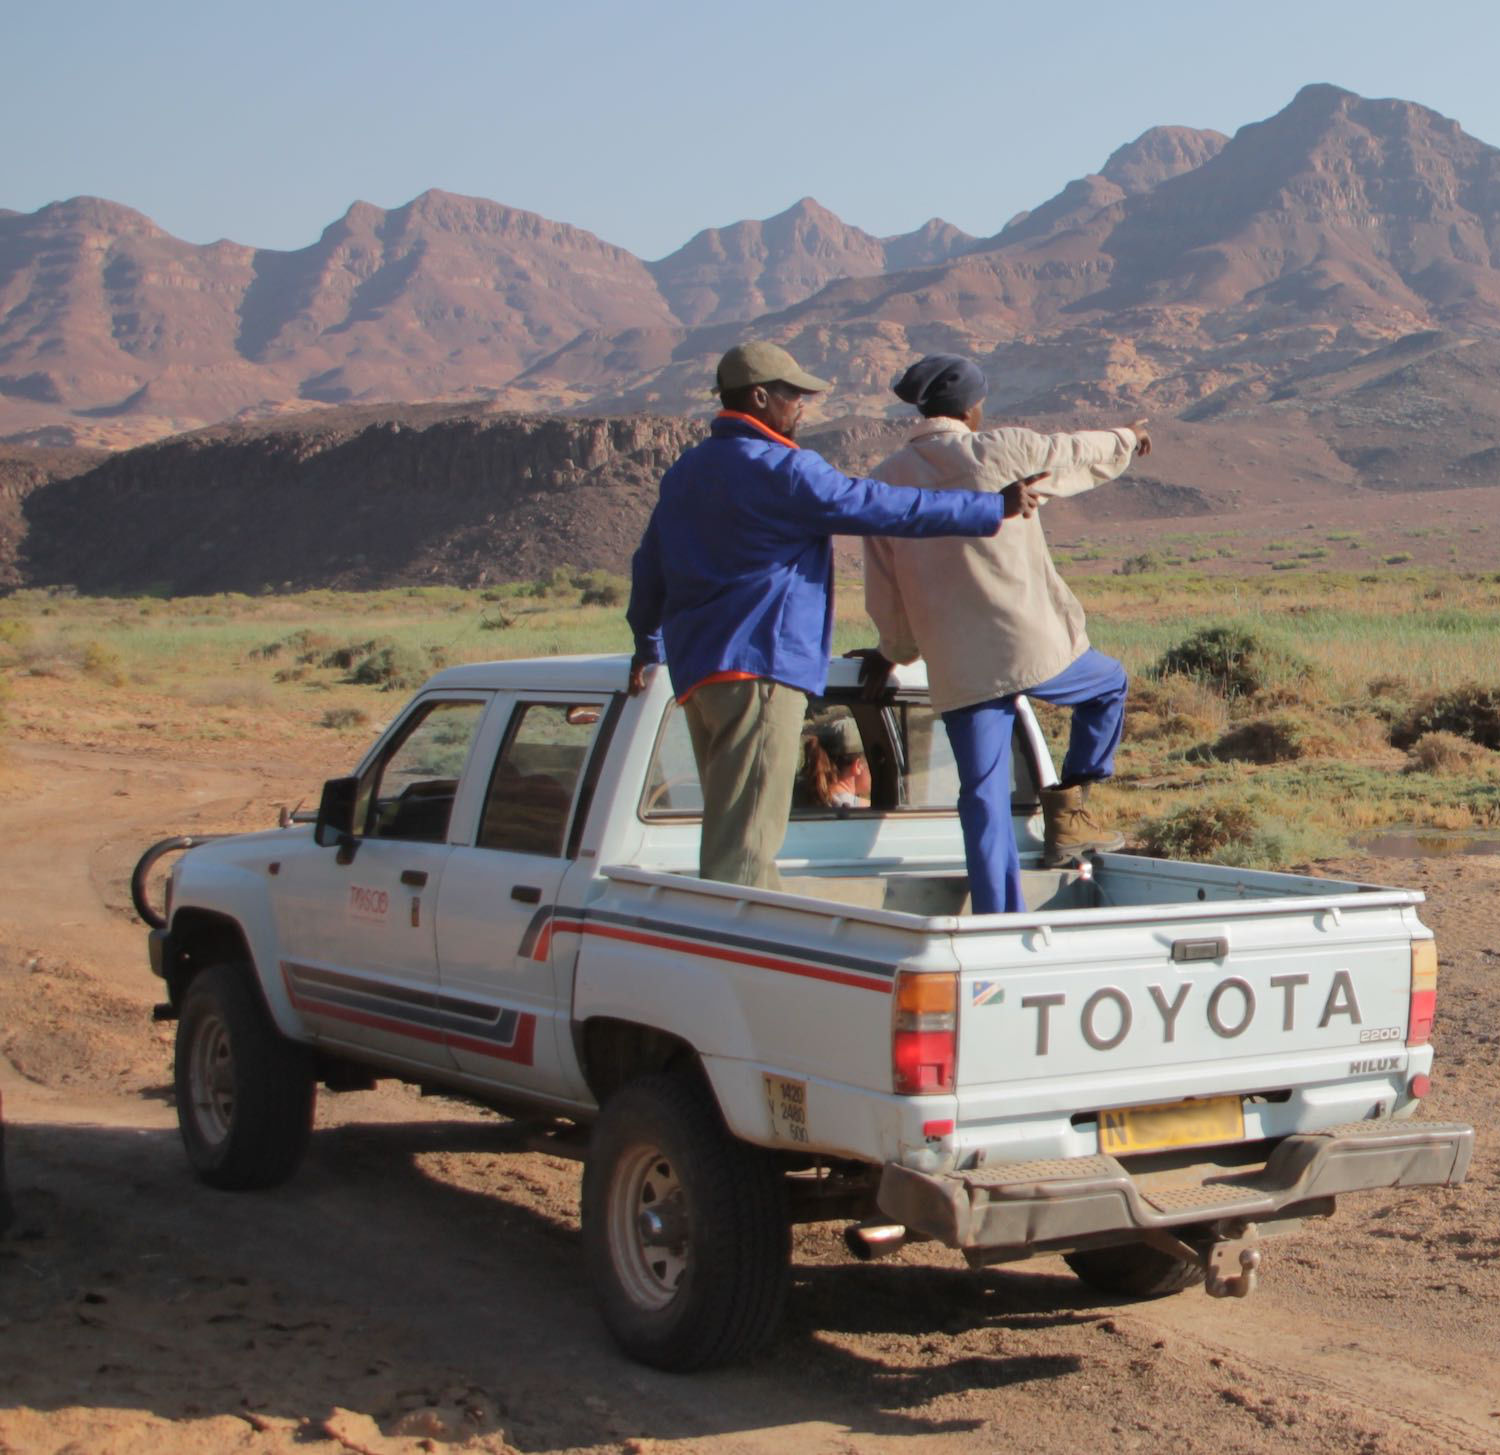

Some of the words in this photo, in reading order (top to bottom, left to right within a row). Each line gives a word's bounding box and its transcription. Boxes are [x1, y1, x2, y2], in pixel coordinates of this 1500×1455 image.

[1021, 969, 1362, 1056] TOYOTA
[1360, 1027, 1400, 1043] 2200
[1350, 1057, 1400, 1074] HILUX
